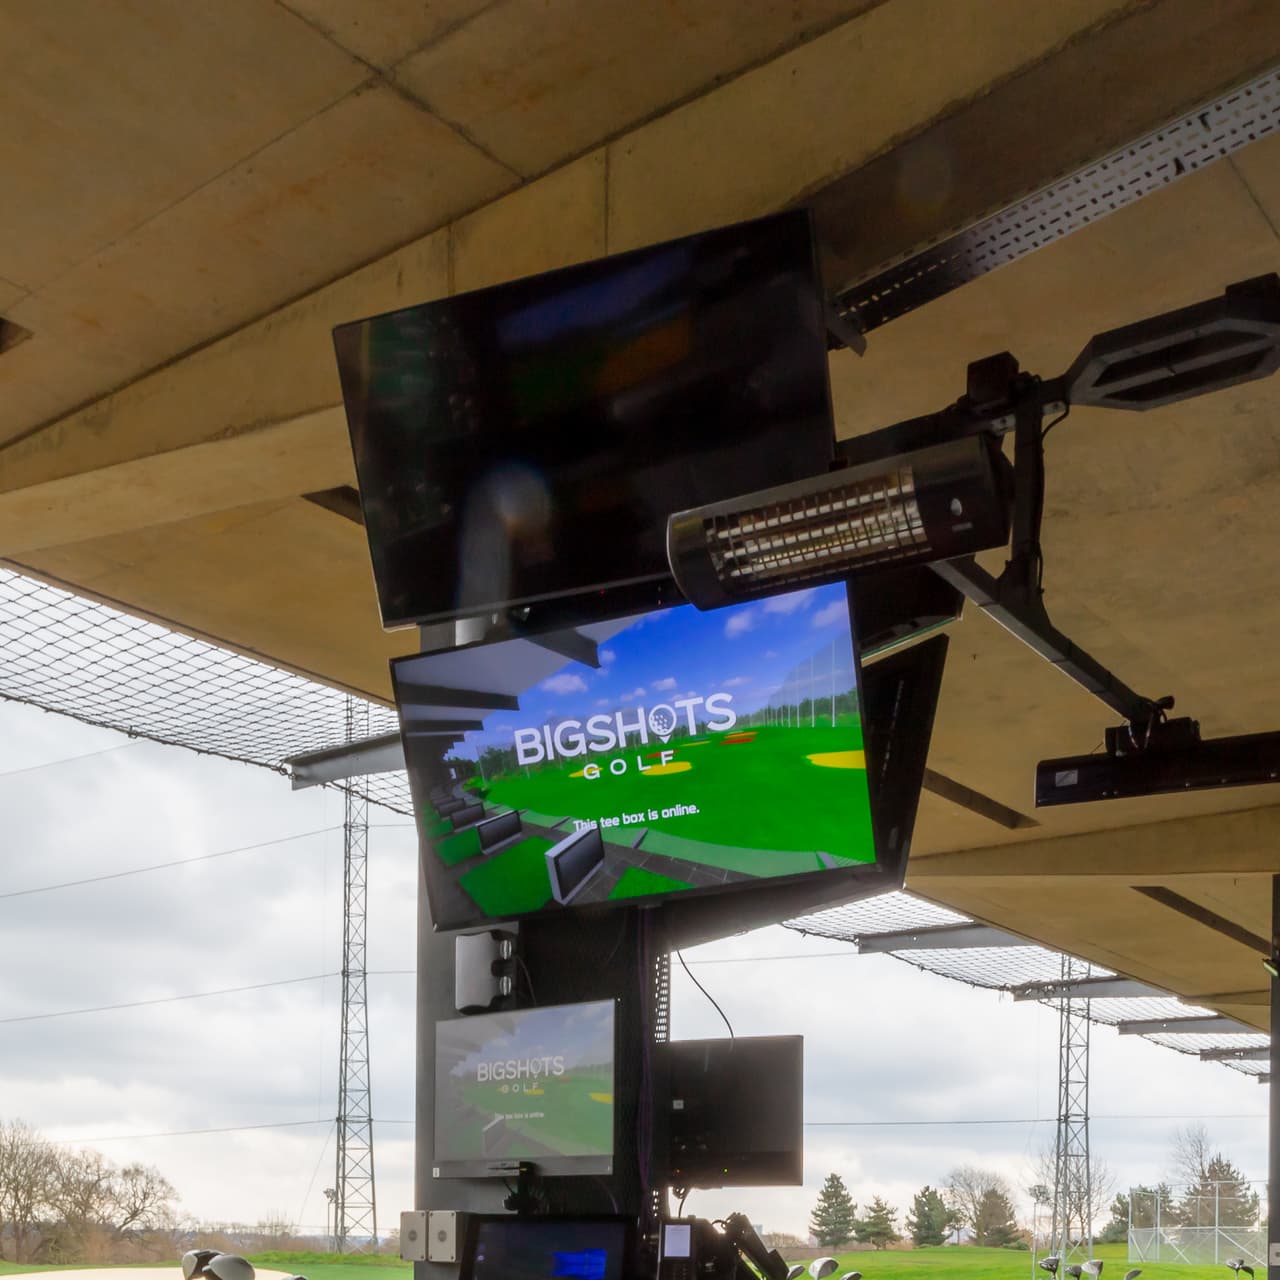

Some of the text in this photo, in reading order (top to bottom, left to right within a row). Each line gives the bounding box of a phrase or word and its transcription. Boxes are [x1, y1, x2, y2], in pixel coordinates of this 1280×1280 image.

[514, 692, 737, 766] BIGSHOTS
[583, 749, 674, 780] GOLF
[573, 803, 700, 833] This tee box is online.
[477, 1055, 565, 1081] BIGSHOTS
[502, 1082, 539, 1094] GOLF
